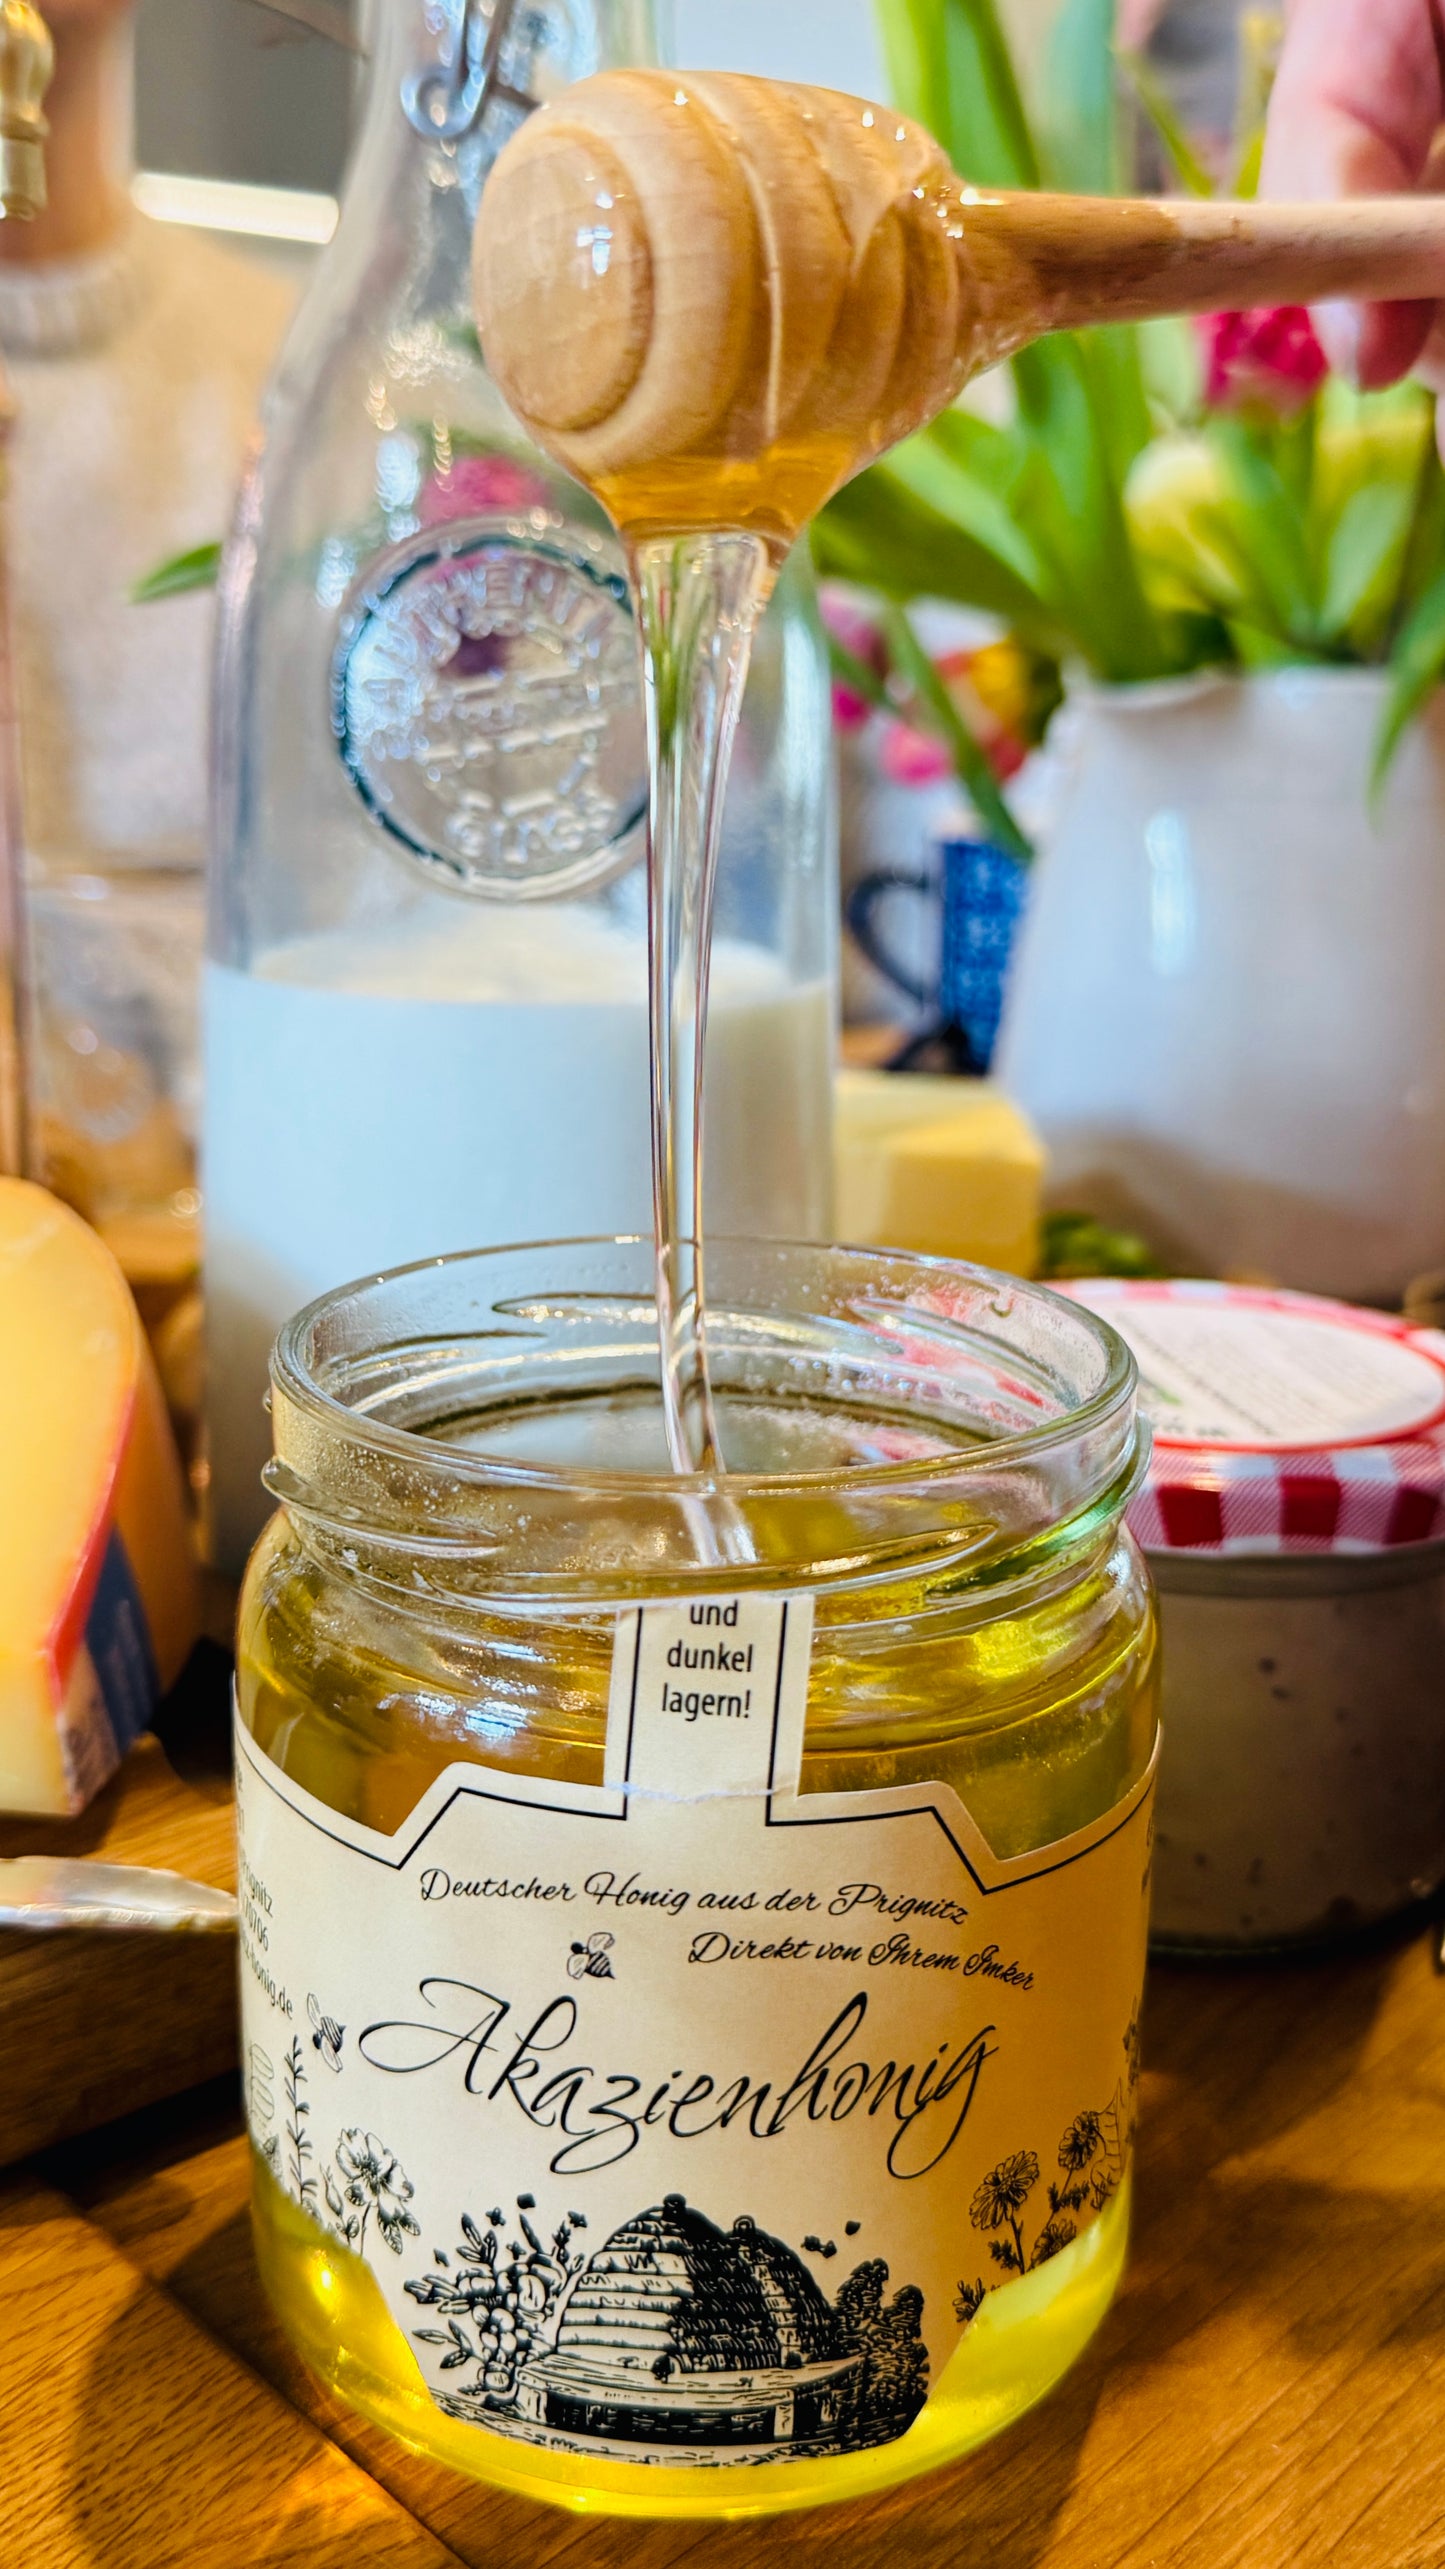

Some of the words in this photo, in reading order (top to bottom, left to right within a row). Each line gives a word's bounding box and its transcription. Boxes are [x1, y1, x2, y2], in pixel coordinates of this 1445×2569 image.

[689, 1600, 738, 1627] und
[667, 1639, 753, 1672] dunkel
[662, 1682, 751, 1722] lagern!
[420, 1868, 577, 1901] Deutscher
[584, 1871, 690, 1916] Honig
[697, 1891, 760, 1910] aus
[764, 1888, 822, 1912] der
[828, 1883, 969, 1925] Prignitz
[688, 1931, 809, 1964] Direkt
[815, 1942, 863, 1962] von
[868, 1933, 960, 1967] Ihrem
[963, 1944, 1034, 1991] Imker
[358, 1976, 1000, 2180] Akazienhonig
